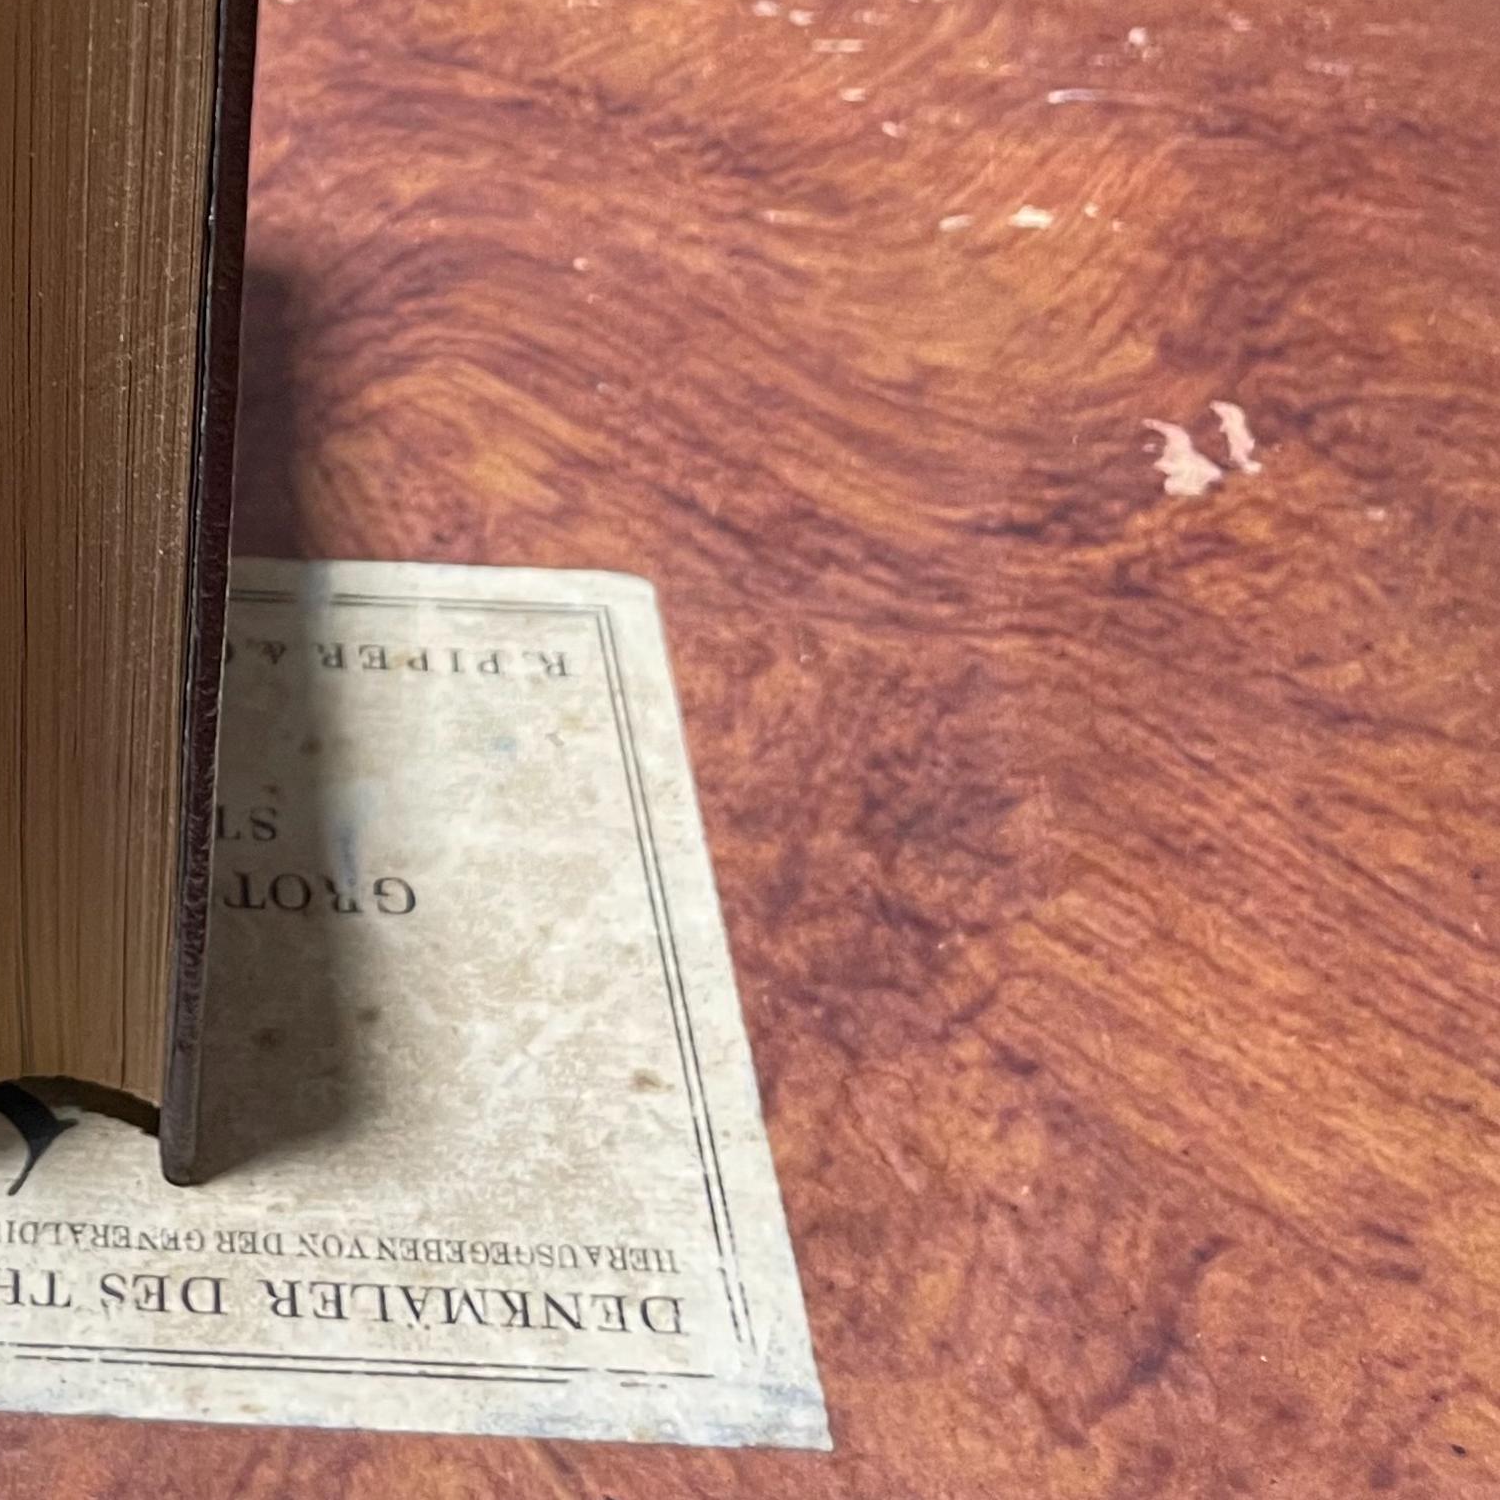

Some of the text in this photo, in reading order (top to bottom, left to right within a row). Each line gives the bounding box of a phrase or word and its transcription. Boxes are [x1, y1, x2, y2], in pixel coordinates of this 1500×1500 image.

[312, 643, 500, 676] PIPER
[222, 870, 417, 916] GROT
[216, 1230, 284, 1257] DER
[296, 1232, 369, 1261] VON
[376, 1238, 680, 1275] HERAUSGEGEBEN
[98, 1271, 229, 1316] DES
[257, 1278, 685, 1336] DENKMÄLER
